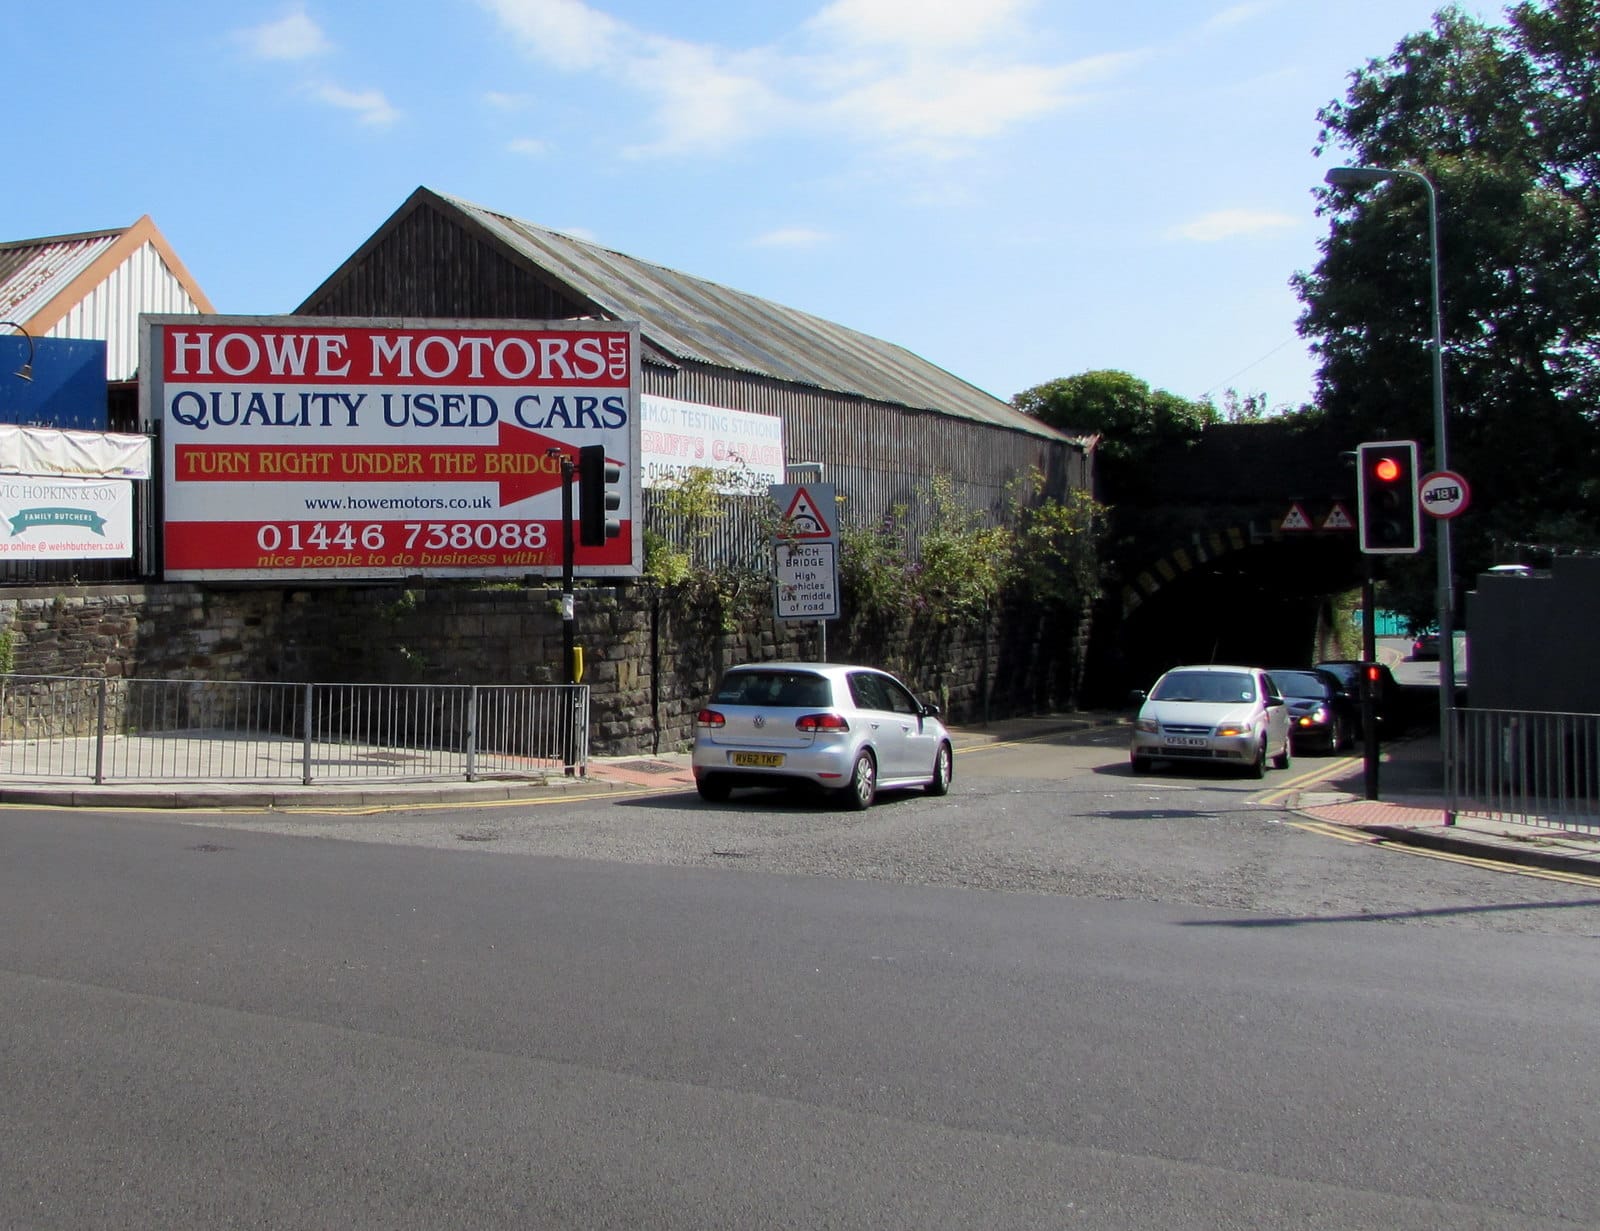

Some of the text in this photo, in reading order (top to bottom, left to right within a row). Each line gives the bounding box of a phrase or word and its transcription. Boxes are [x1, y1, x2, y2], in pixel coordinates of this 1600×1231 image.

[171, 332, 627, 381] HOWE MOTORS LTD
[171, 390, 628, 430] QUALITY USED CARS
[680, 409, 728, 432] TESTING
[731, 418, 774, 438] STATION
[640, 429, 782, 466] GRIFF'S GARAGE
[183, 451, 571, 475] TURN RIGHT UNDER THE BRIDG
[23, 485, 78, 501] HOPKINS
[80, 488, 91, 501] &
[93, 488, 117, 501] SON
[305, 495, 492, 510] www.howemotors.co.uk
[24, 512, 93, 522] FAMILY BUTCHERS
[256, 521, 547, 551] 01446 738088
[11, 541, 37, 551] online
[38, 541, 47, 552] @
[48, 541, 125, 552] welshbutchers.co.uk
[789, 548, 819, 557] RCH
[257, 551, 544, 568] nice people to do business with!
[785, 558, 825, 568] BRIDGE
[795, 572, 816, 581] High
[786, 581, 825, 590] ehicles
[800, 591, 832, 601] middle
[790, 602, 825, 612] of road
